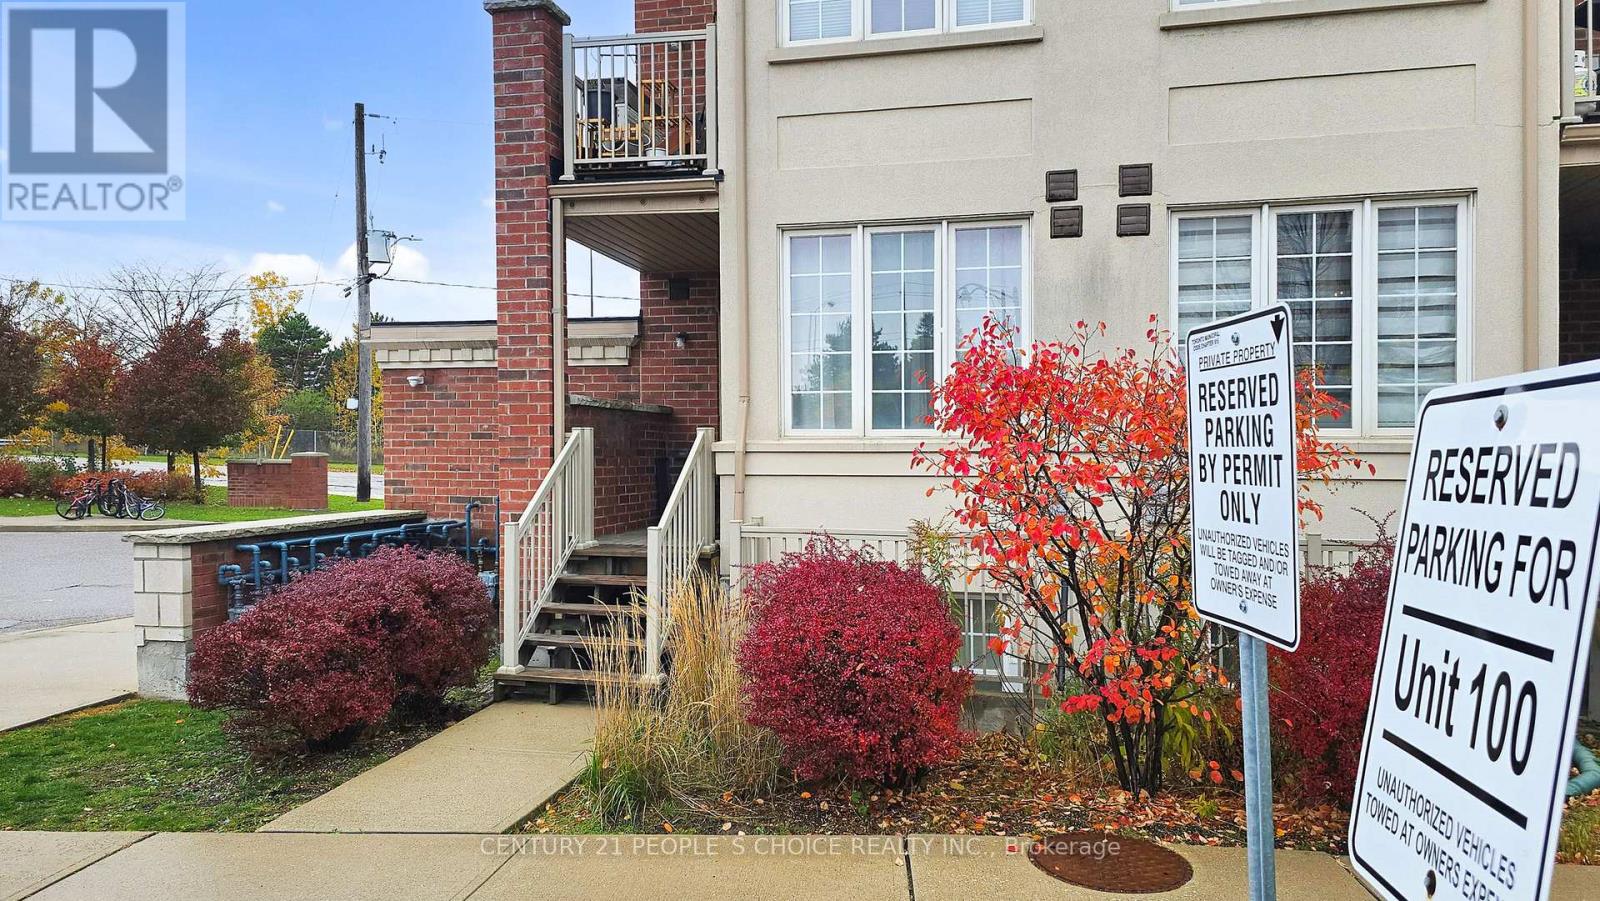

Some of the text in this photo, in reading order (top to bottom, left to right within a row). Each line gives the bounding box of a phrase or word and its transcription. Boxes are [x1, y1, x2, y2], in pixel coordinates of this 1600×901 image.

[1199, 352, 1231, 368] PRIVATE
[1233, 342, 1276, 363] PROPERTY
[1198, 372, 1279, 412] RESERVED
[1205, 413, 1274, 448] PARKING
[1199, 453, 1283, 488] BY PERMIT
[1422, 442, 1581, 509] RESERVED
[1220, 489, 1261, 525] ONLY
[1198, 528, 1290, 558] UNAUTHORIZED VEHICLES
[1199, 544, 1289, 576] WILL BE TAGGED AND/OR
[1214, 562, 1273, 589] TOWED AWAY AT
[1404, 522, 1577, 610] PARKING FOR
[1245, 588, 1277, 609] EXPENSE
[1394, 633, 1537, 776] Unit 100
[1376, 766, 1517, 890] UNAUTHORIZED VEHICLES
[1366, 792, 1505, 901] TOWED AT OWNERS EXP
